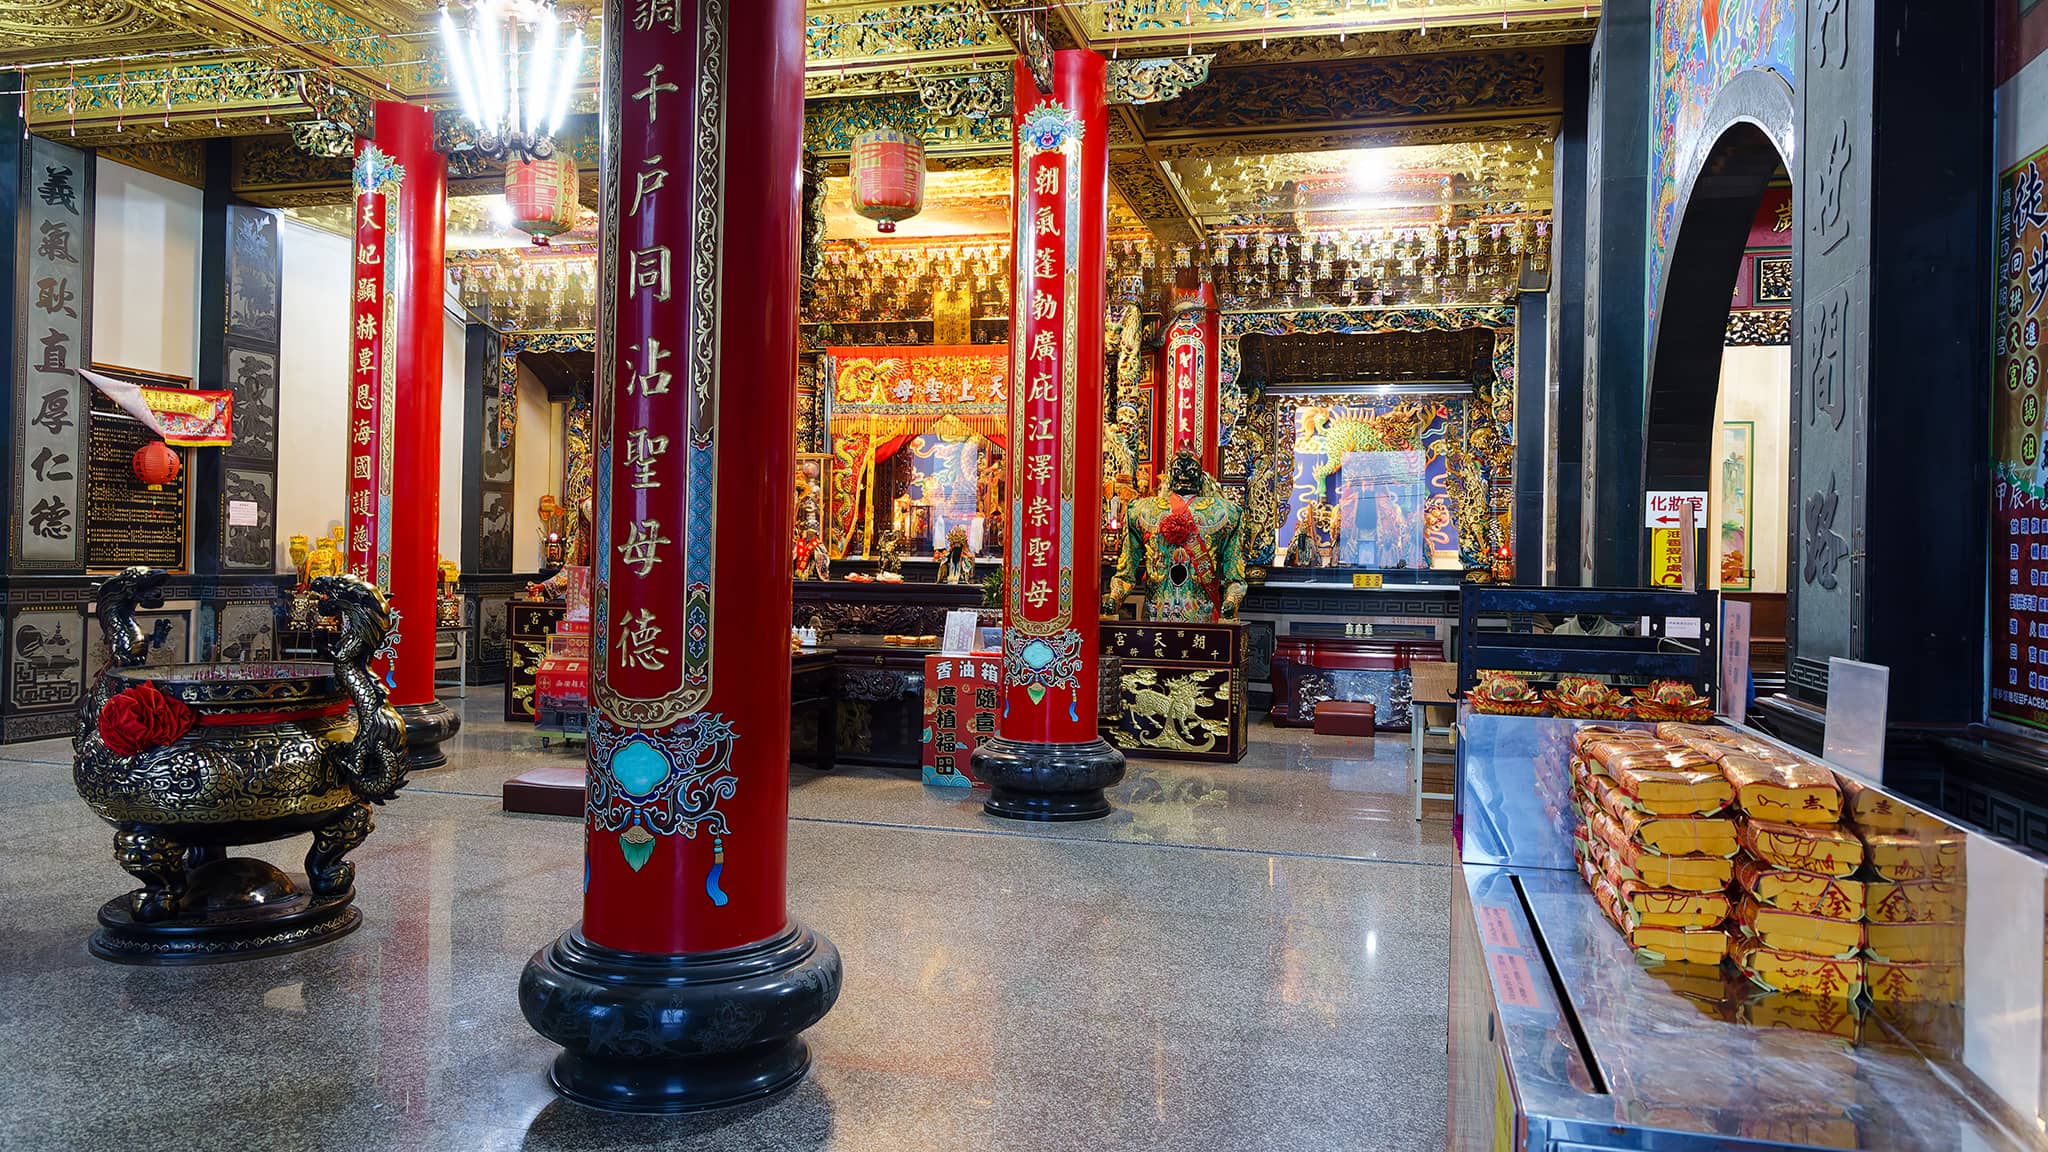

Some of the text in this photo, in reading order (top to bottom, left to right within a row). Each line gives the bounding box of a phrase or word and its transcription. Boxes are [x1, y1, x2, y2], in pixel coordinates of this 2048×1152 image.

[29, 165, 79, 541] 義氣耿直厚仁德
[893, 375, 1008, 402] 天上聖母
[1024, 164, 1061, 609] 朝氣蓬勃廣庇江澤崇聖母
[1114, 631, 1206, 650] 朝天宮
[935, 660, 999, 684] 香油箱
[935, 685, 958, 776] 廣植福田
